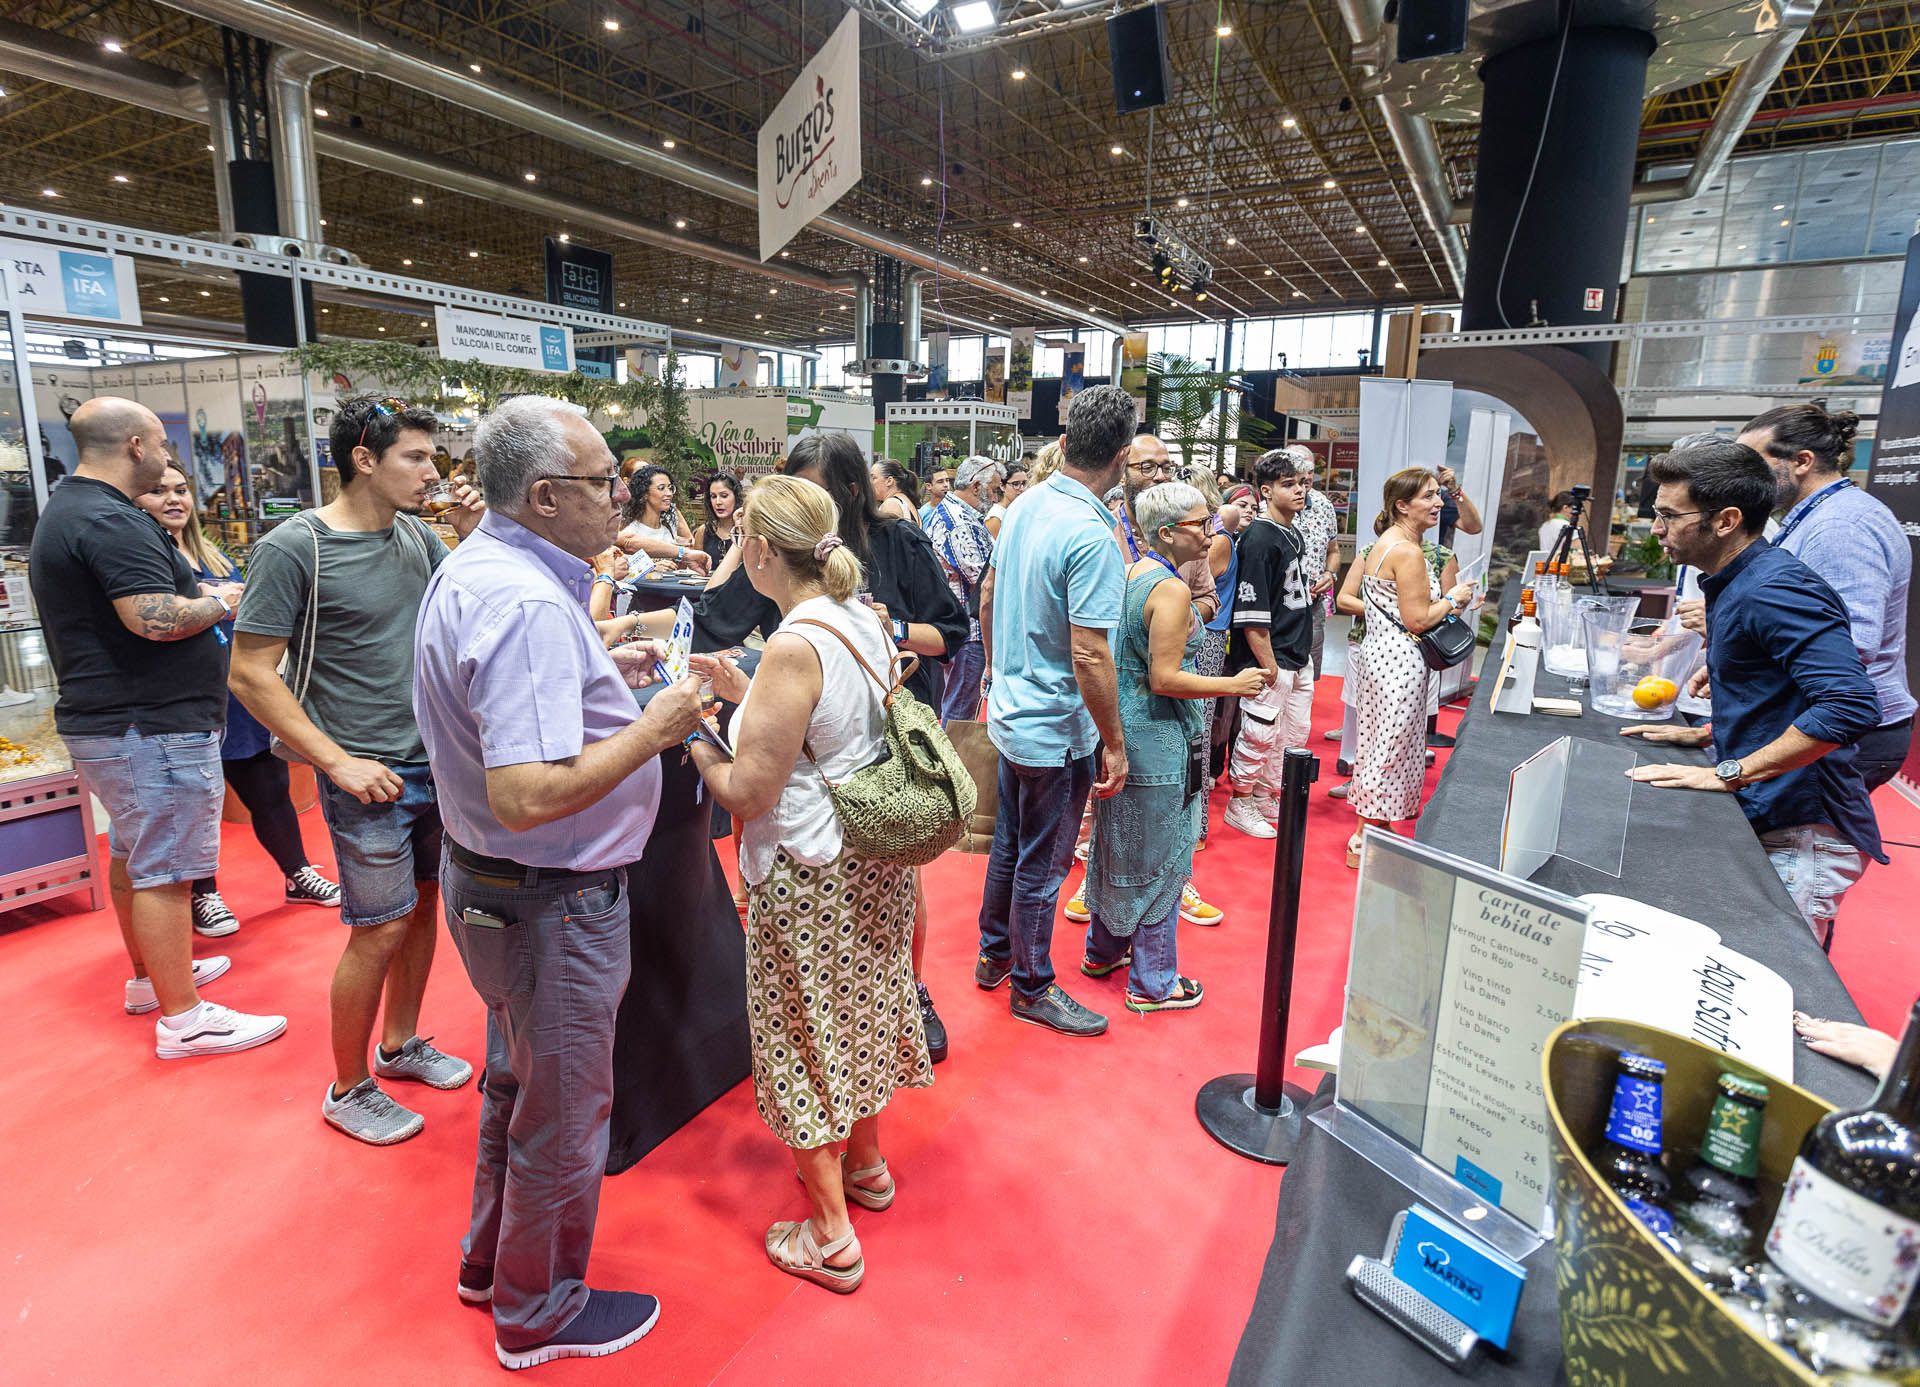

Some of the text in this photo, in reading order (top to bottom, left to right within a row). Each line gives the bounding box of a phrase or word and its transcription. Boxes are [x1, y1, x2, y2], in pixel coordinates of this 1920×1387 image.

[776, 87, 834, 185] Burgos
[14, 259, 46, 277] RTA
[72, 277, 107, 297] IFA
[455, 324, 533, 344] MANCOMUNITAT DE
[495, 342, 506, 352] EL
[506, 344, 537, 356] COMTAT
[545, 344, 563, 356] IFA
[702, 420, 756, 447] Ven a
[715, 437, 784, 455] descubrir
[721, 451, 732, 466] tu
[1478, 889, 1562, 931] Carta de
[1480, 906, 1554, 947] bebidas
[1452, 922, 1539, 966] Vermut Cantueso
[1470, 943, 1488, 959] Oro
[1491, 952, 1514, 969] Rojo
[1462, 965, 1512, 996] Vino tinto
[1463, 980, 1476, 993] La
[1479, 987, 1507, 1007] Dama
[1692, 955, 1748, 1016] Aquí
[1454, 999, 1511, 1035] Vino blanco
[1459, 1016, 1502, 1044] La Dama
[1436, 1042, 1473, 1069] Estrella
[1475, 1063, 1516, 1092] Levante
[1457, 1040, 1497, 1068] Cerveza
[1432, 1063, 1516, 1116] Cerveza sin alcohol
[1436, 1077, 1469, 1102] Estrella
[1471, 1098, 1507, 1123] Levante
[1449, 1107, 1493, 1139] Refresco
[1457, 1135, 1538, 1167] Agua 2€
[1423, 1253, 1483, 1301] MARTINO
